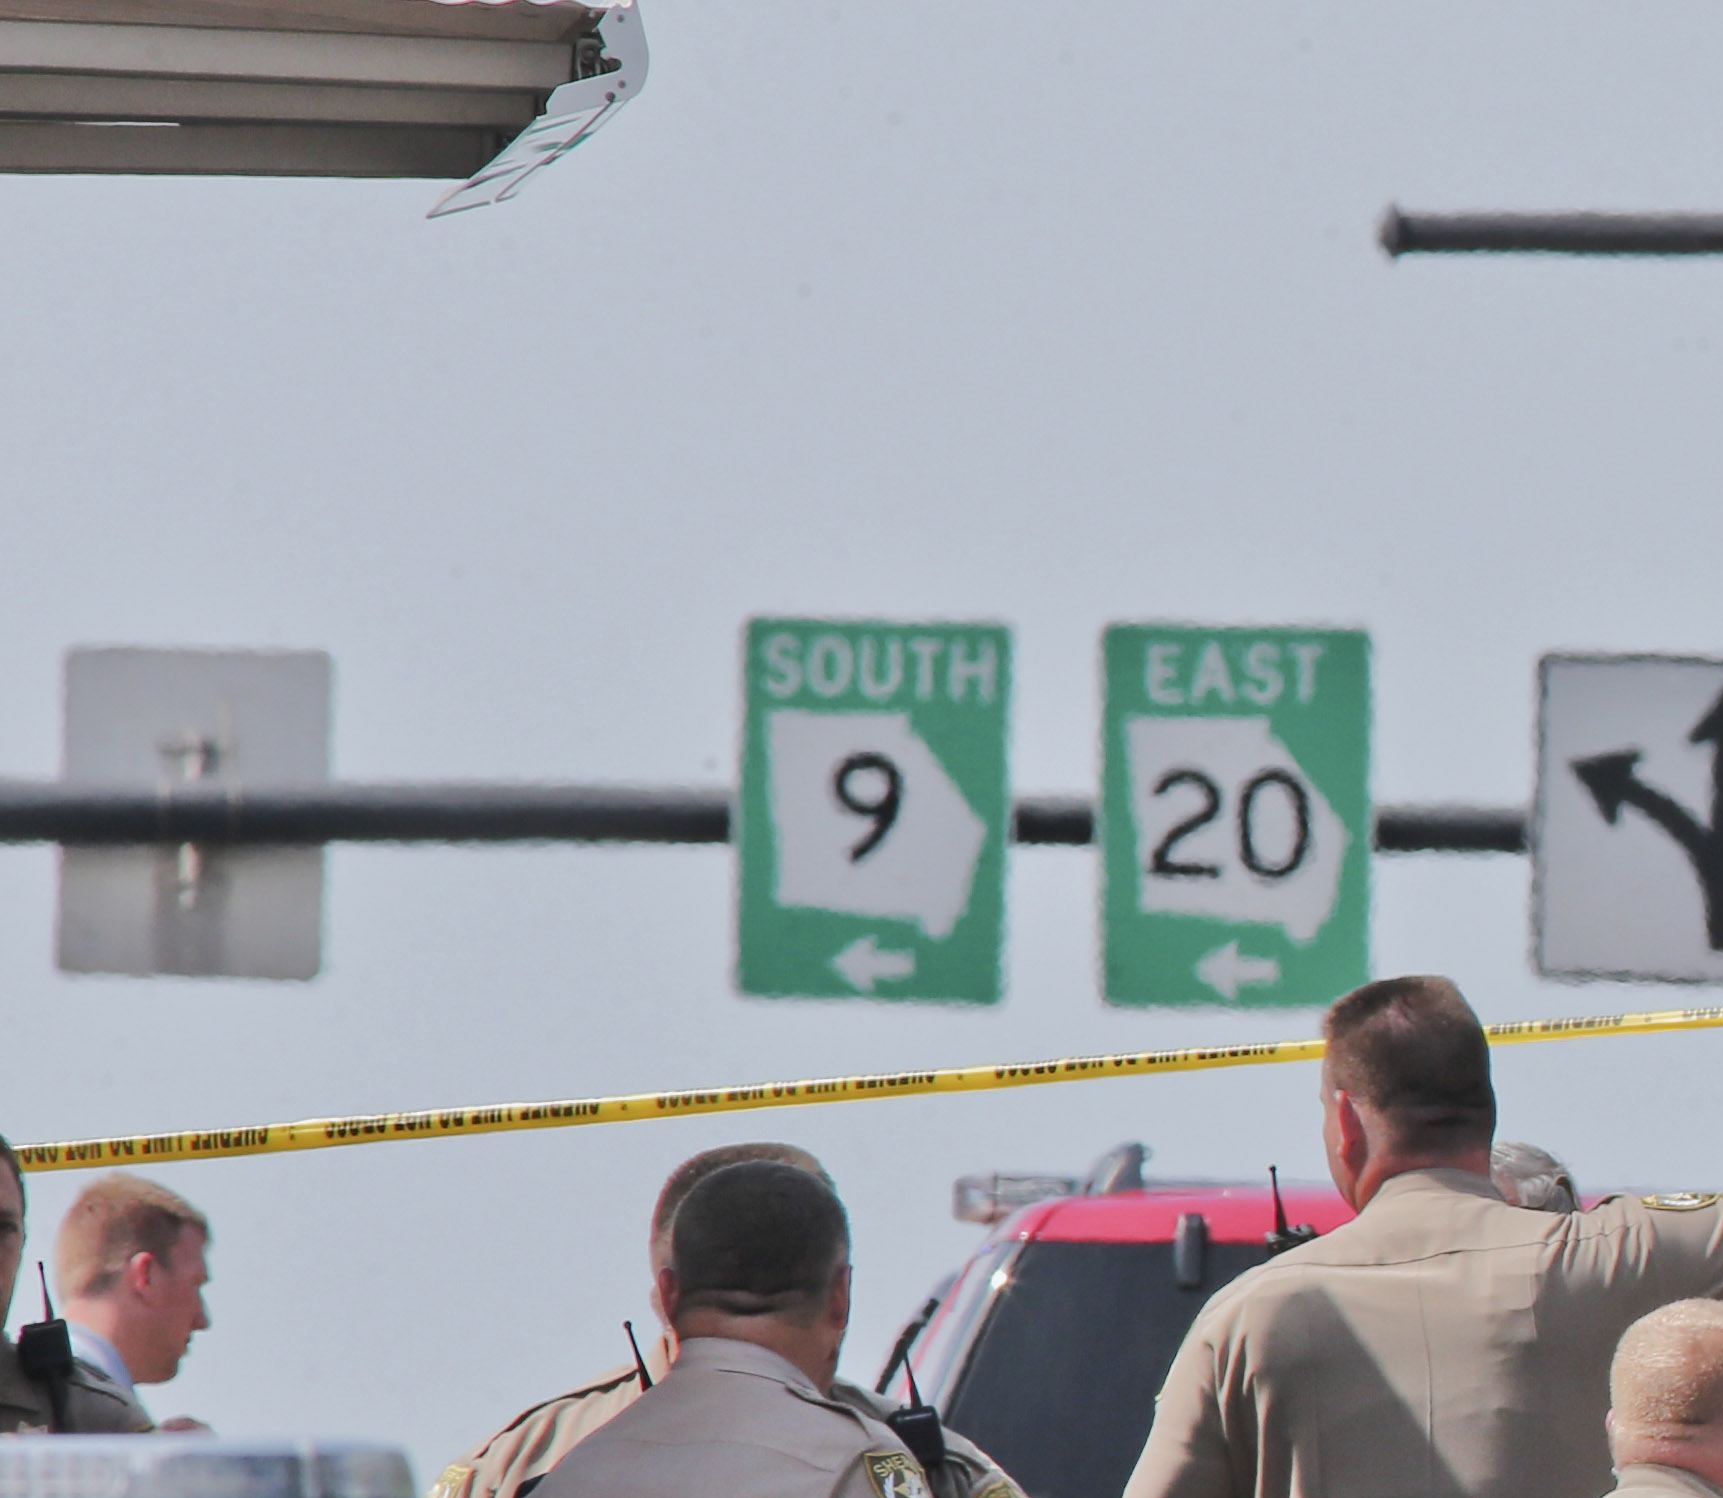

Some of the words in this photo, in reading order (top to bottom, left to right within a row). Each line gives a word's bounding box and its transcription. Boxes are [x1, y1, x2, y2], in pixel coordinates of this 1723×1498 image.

[763, 632, 1000, 702] SOUTH
[1143, 641, 1324, 706] EAST
[832, 750, 905, 864] 9
[1148, 765, 1312, 882] 20
